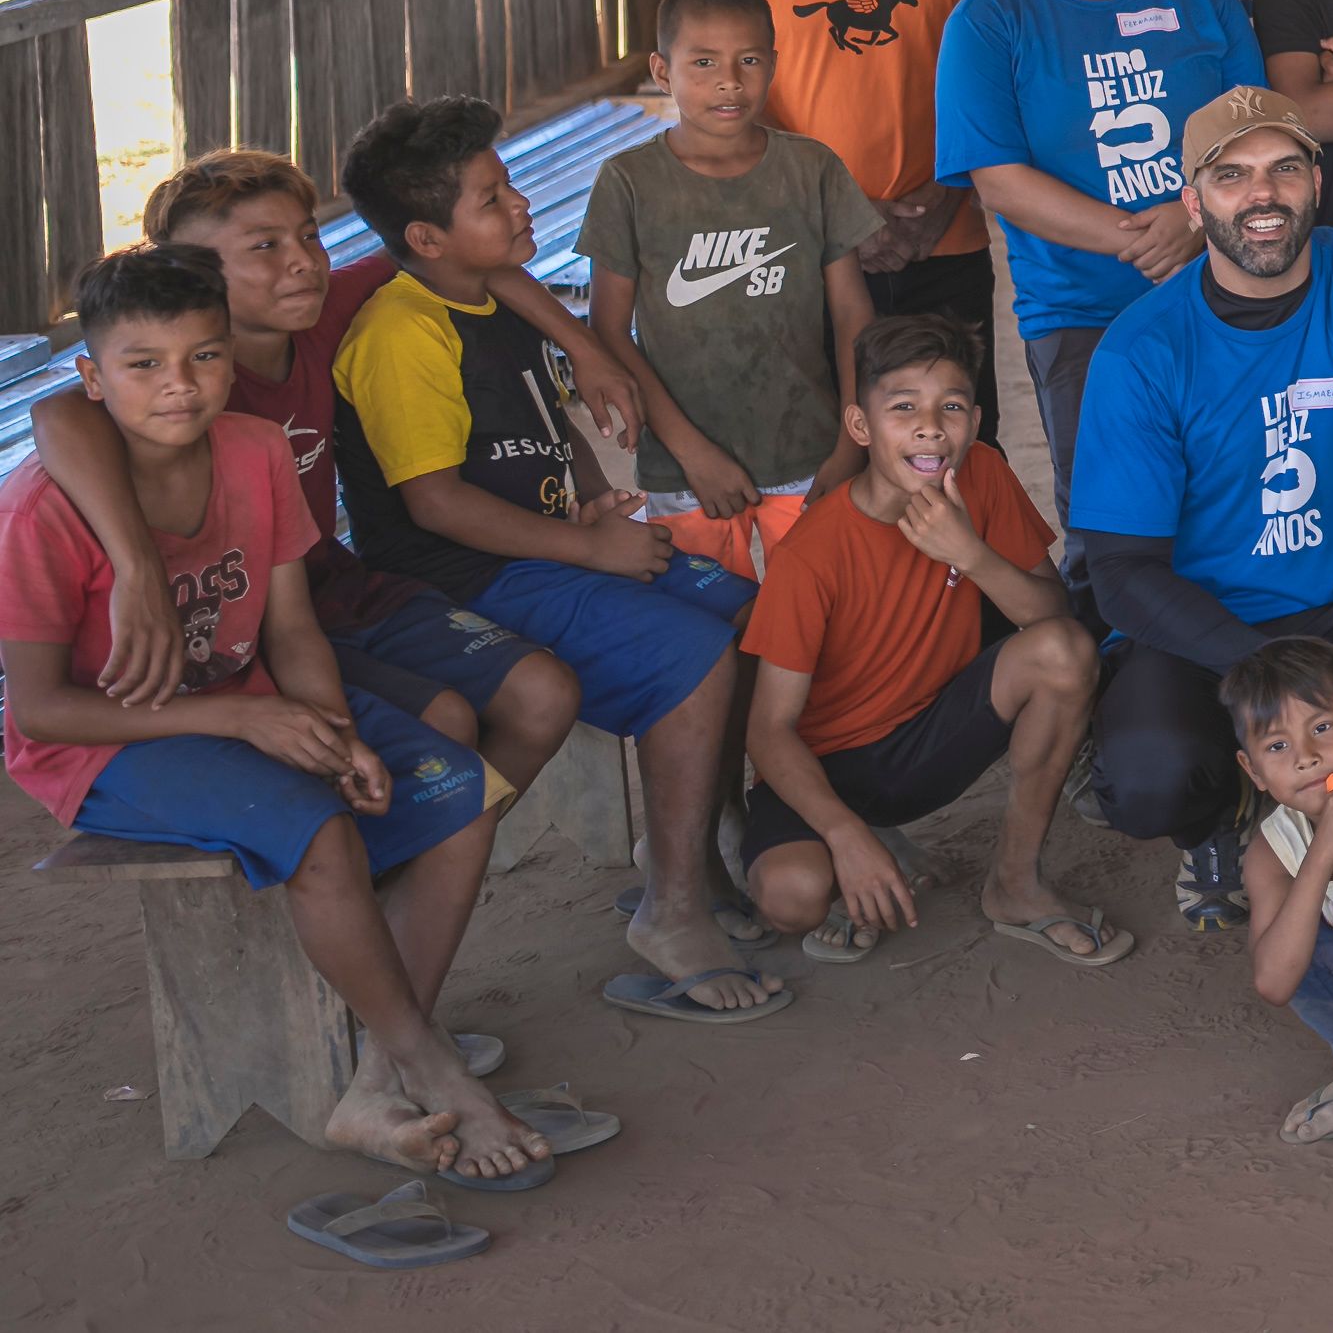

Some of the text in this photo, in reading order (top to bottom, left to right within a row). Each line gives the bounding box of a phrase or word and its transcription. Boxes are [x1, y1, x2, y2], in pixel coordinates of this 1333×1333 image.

[1083, 48, 1147, 78] LITRO
[1087, 69, 1167, 109] DE LUZ
[1089, 103, 1171, 168] 10
[1107, 156, 1183, 205] ANOS
[682, 227, 771, 270] NIKE
[746, 265, 786, 297] SB
[1265, 421, 1290, 458] DE
[1251, 509, 1324, 556] ANOS
[412, 784, 442, 803] FELIZ
[441, 769, 478, 791] NATAL
